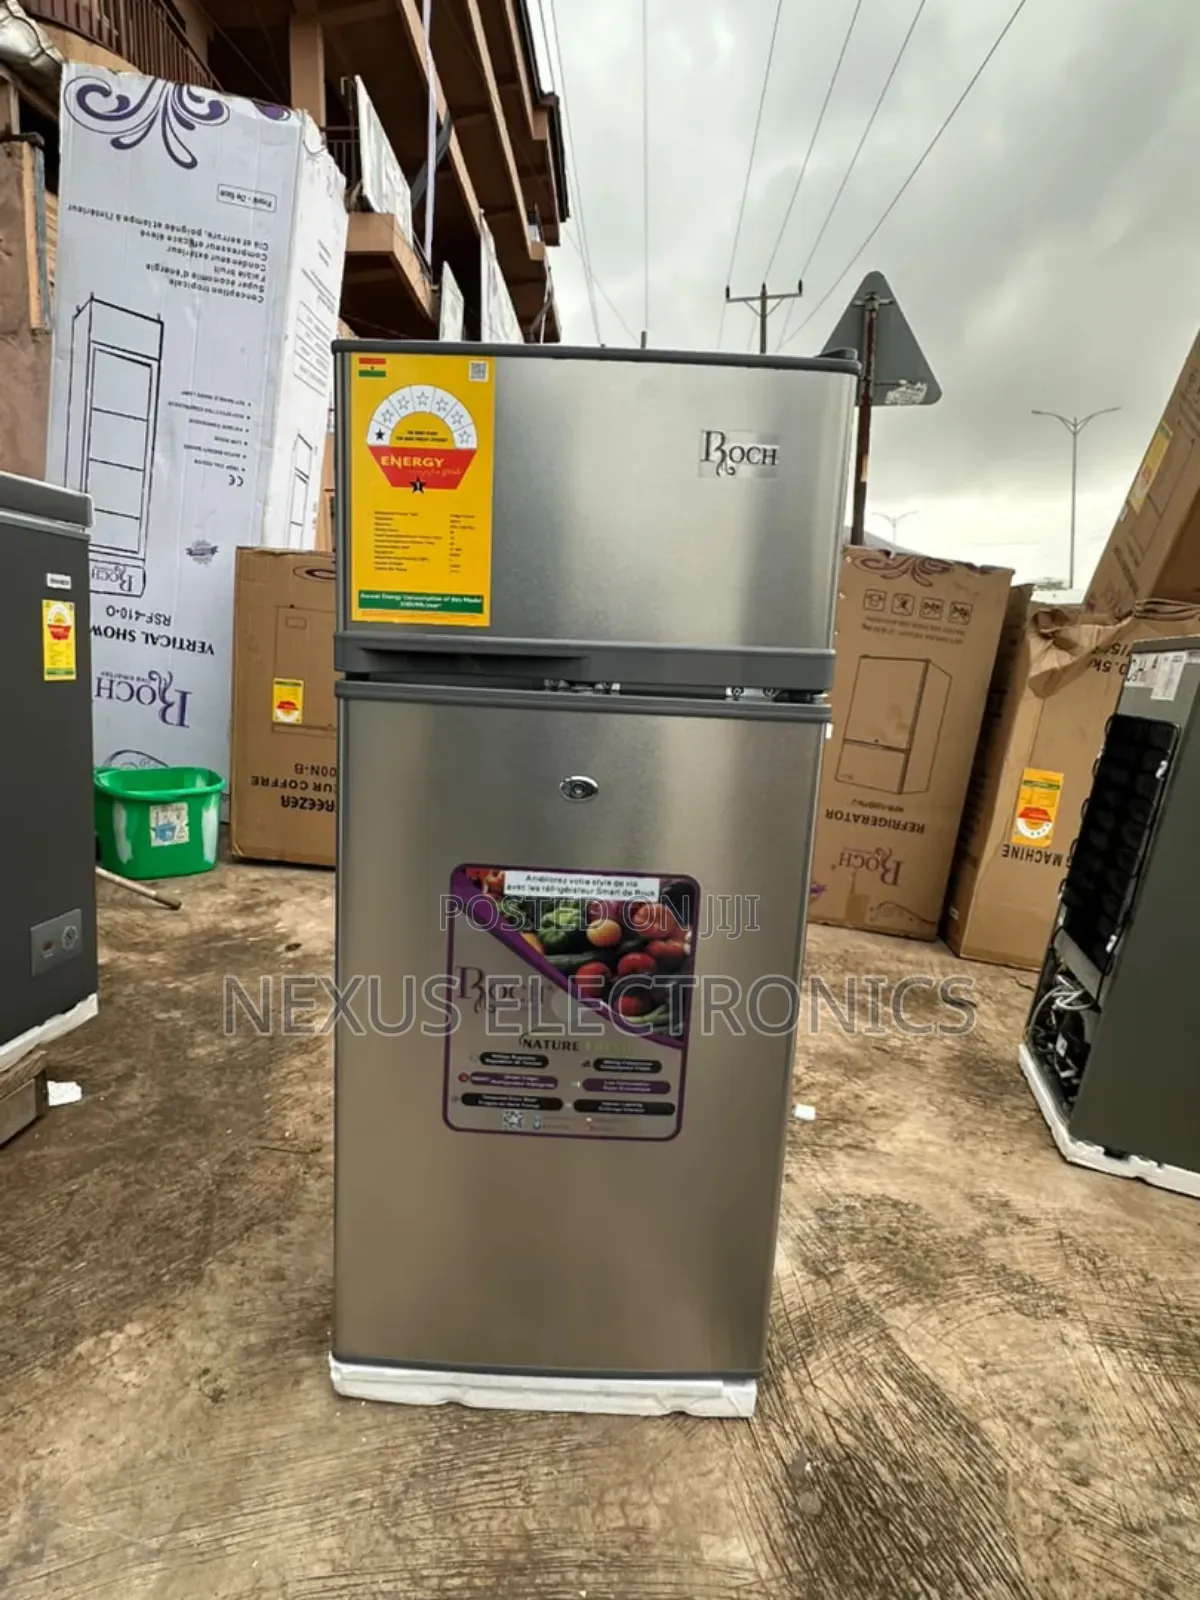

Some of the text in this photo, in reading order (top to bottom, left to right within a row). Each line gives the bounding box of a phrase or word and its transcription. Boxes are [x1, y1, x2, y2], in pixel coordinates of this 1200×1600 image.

[380, 453, 445, 469] ENERGY
[140, 631, 215, 656] VERTICAL
[251, 775, 309, 791] COFFRE
[825, 808, 926, 835] REFRIGERATOR
[1001, 843, 1063, 867] MACHINE
[522, 1038, 581, 1052] NATURE
